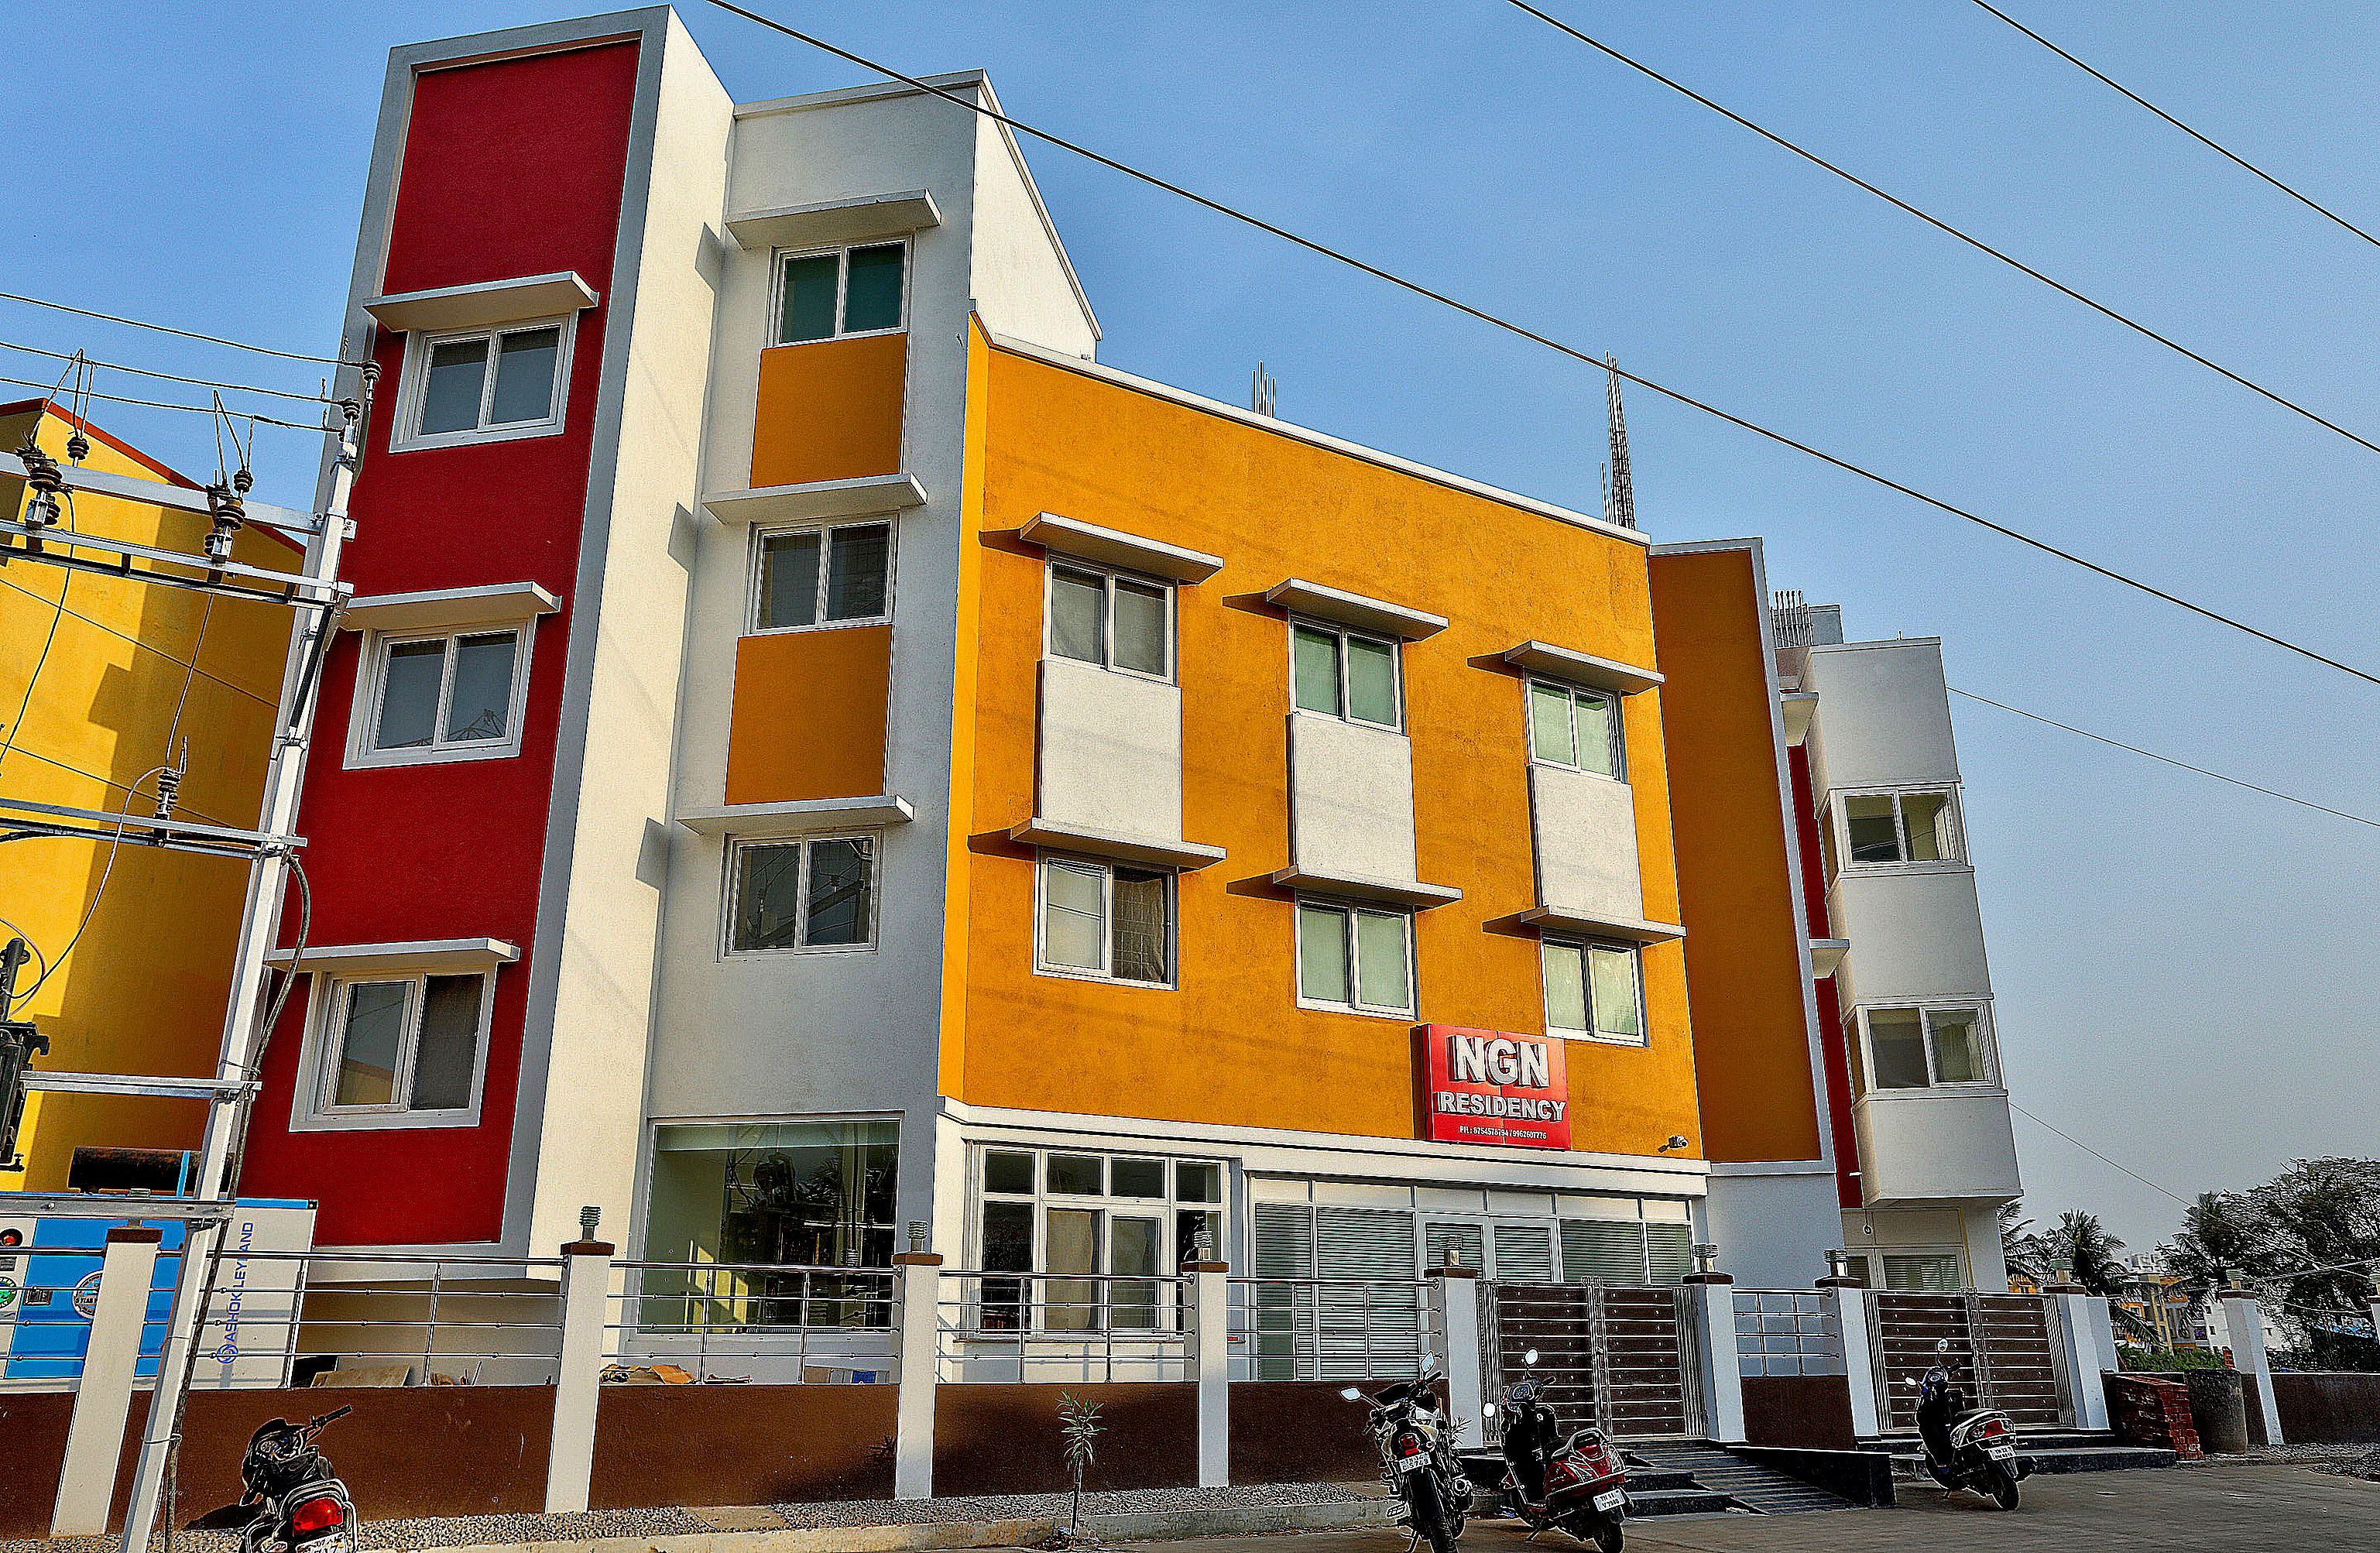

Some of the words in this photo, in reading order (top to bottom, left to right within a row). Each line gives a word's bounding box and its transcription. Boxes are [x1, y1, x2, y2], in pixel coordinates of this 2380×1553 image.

[1447, 1034, 1549, 1088] NGN
[1434, 1091, 1566, 1123] RESIDENCY
[233, 1222, 254, 1288] LEYLAND
[225, 1291, 243, 1342] ASHOK
